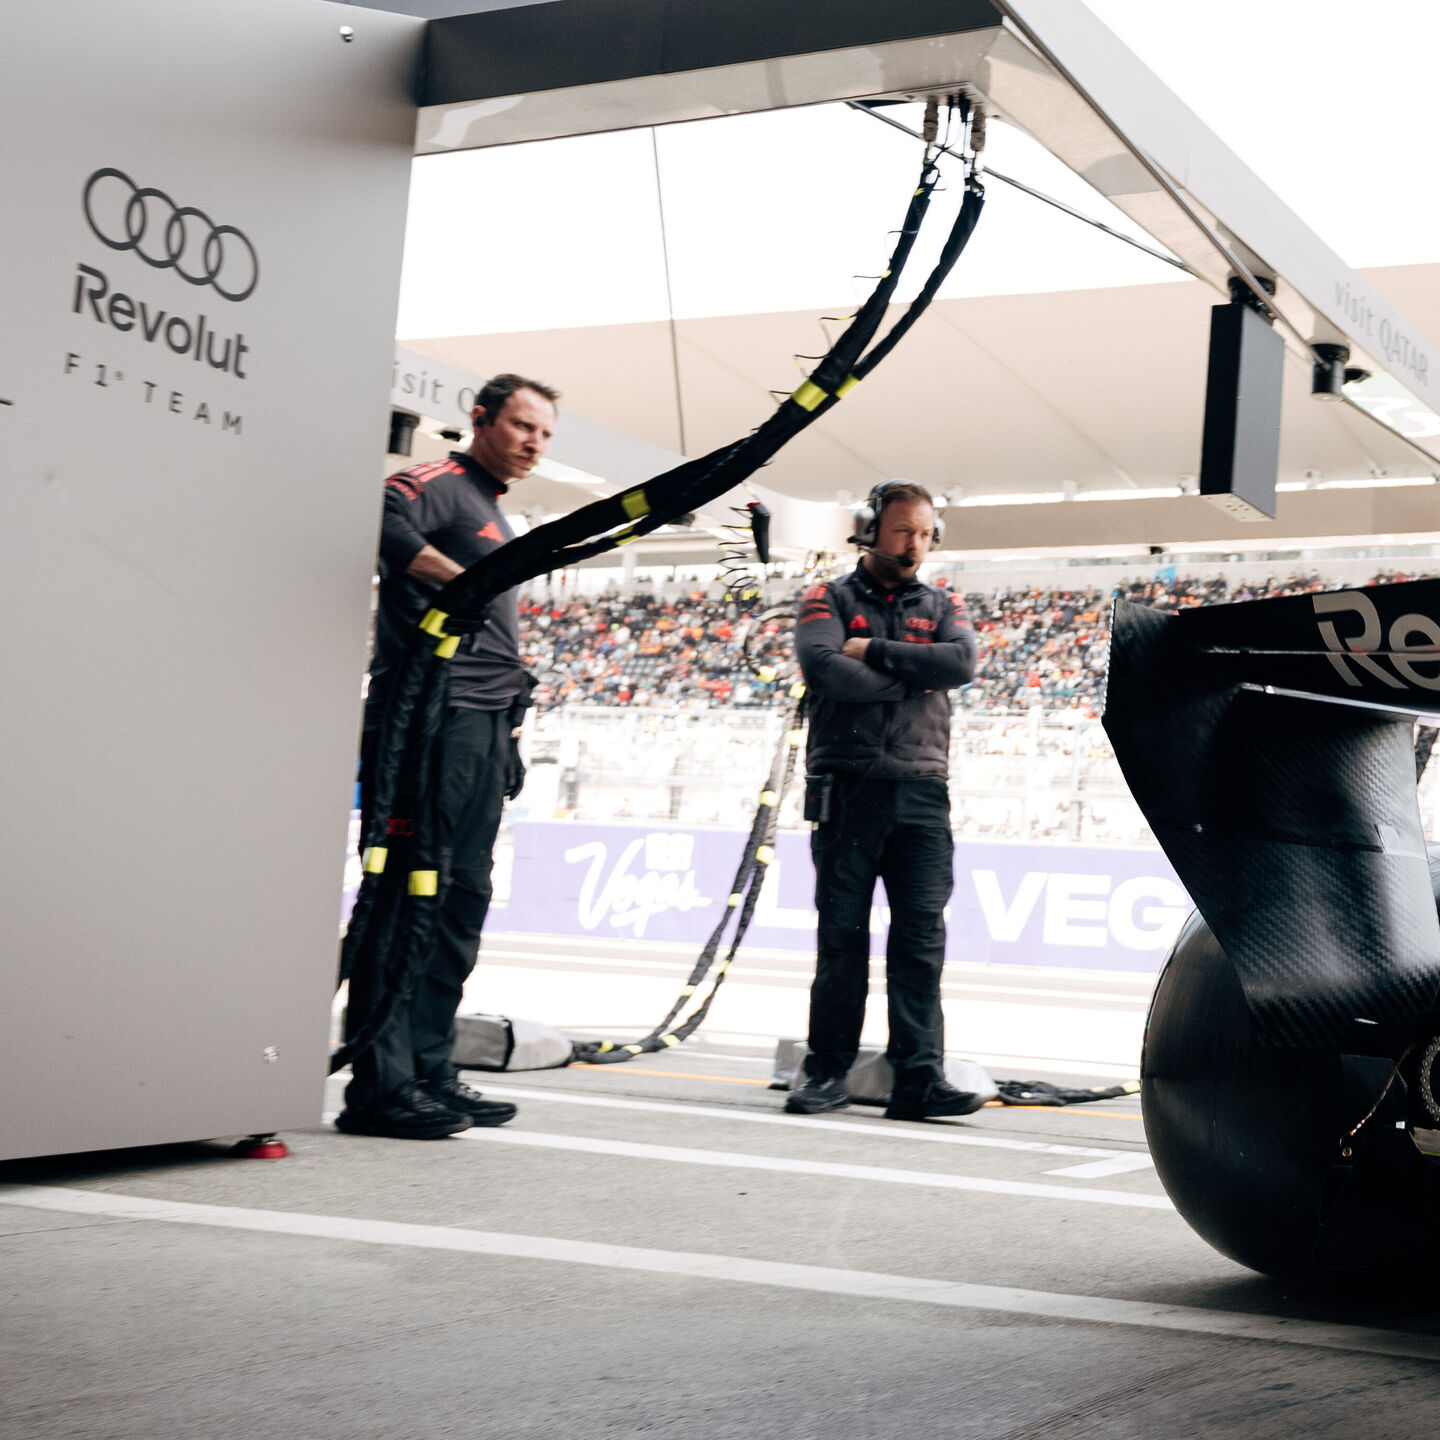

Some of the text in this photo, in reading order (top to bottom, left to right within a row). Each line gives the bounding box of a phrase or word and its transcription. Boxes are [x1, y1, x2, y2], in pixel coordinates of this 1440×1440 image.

[72, 263, 249, 380] Revolut
[1335, 281, 1429, 387] visit QATAR
[143, 380, 243, 435] TEAM
[391, 362, 445, 405] isit
[971, 869, 1190, 952] VEG
